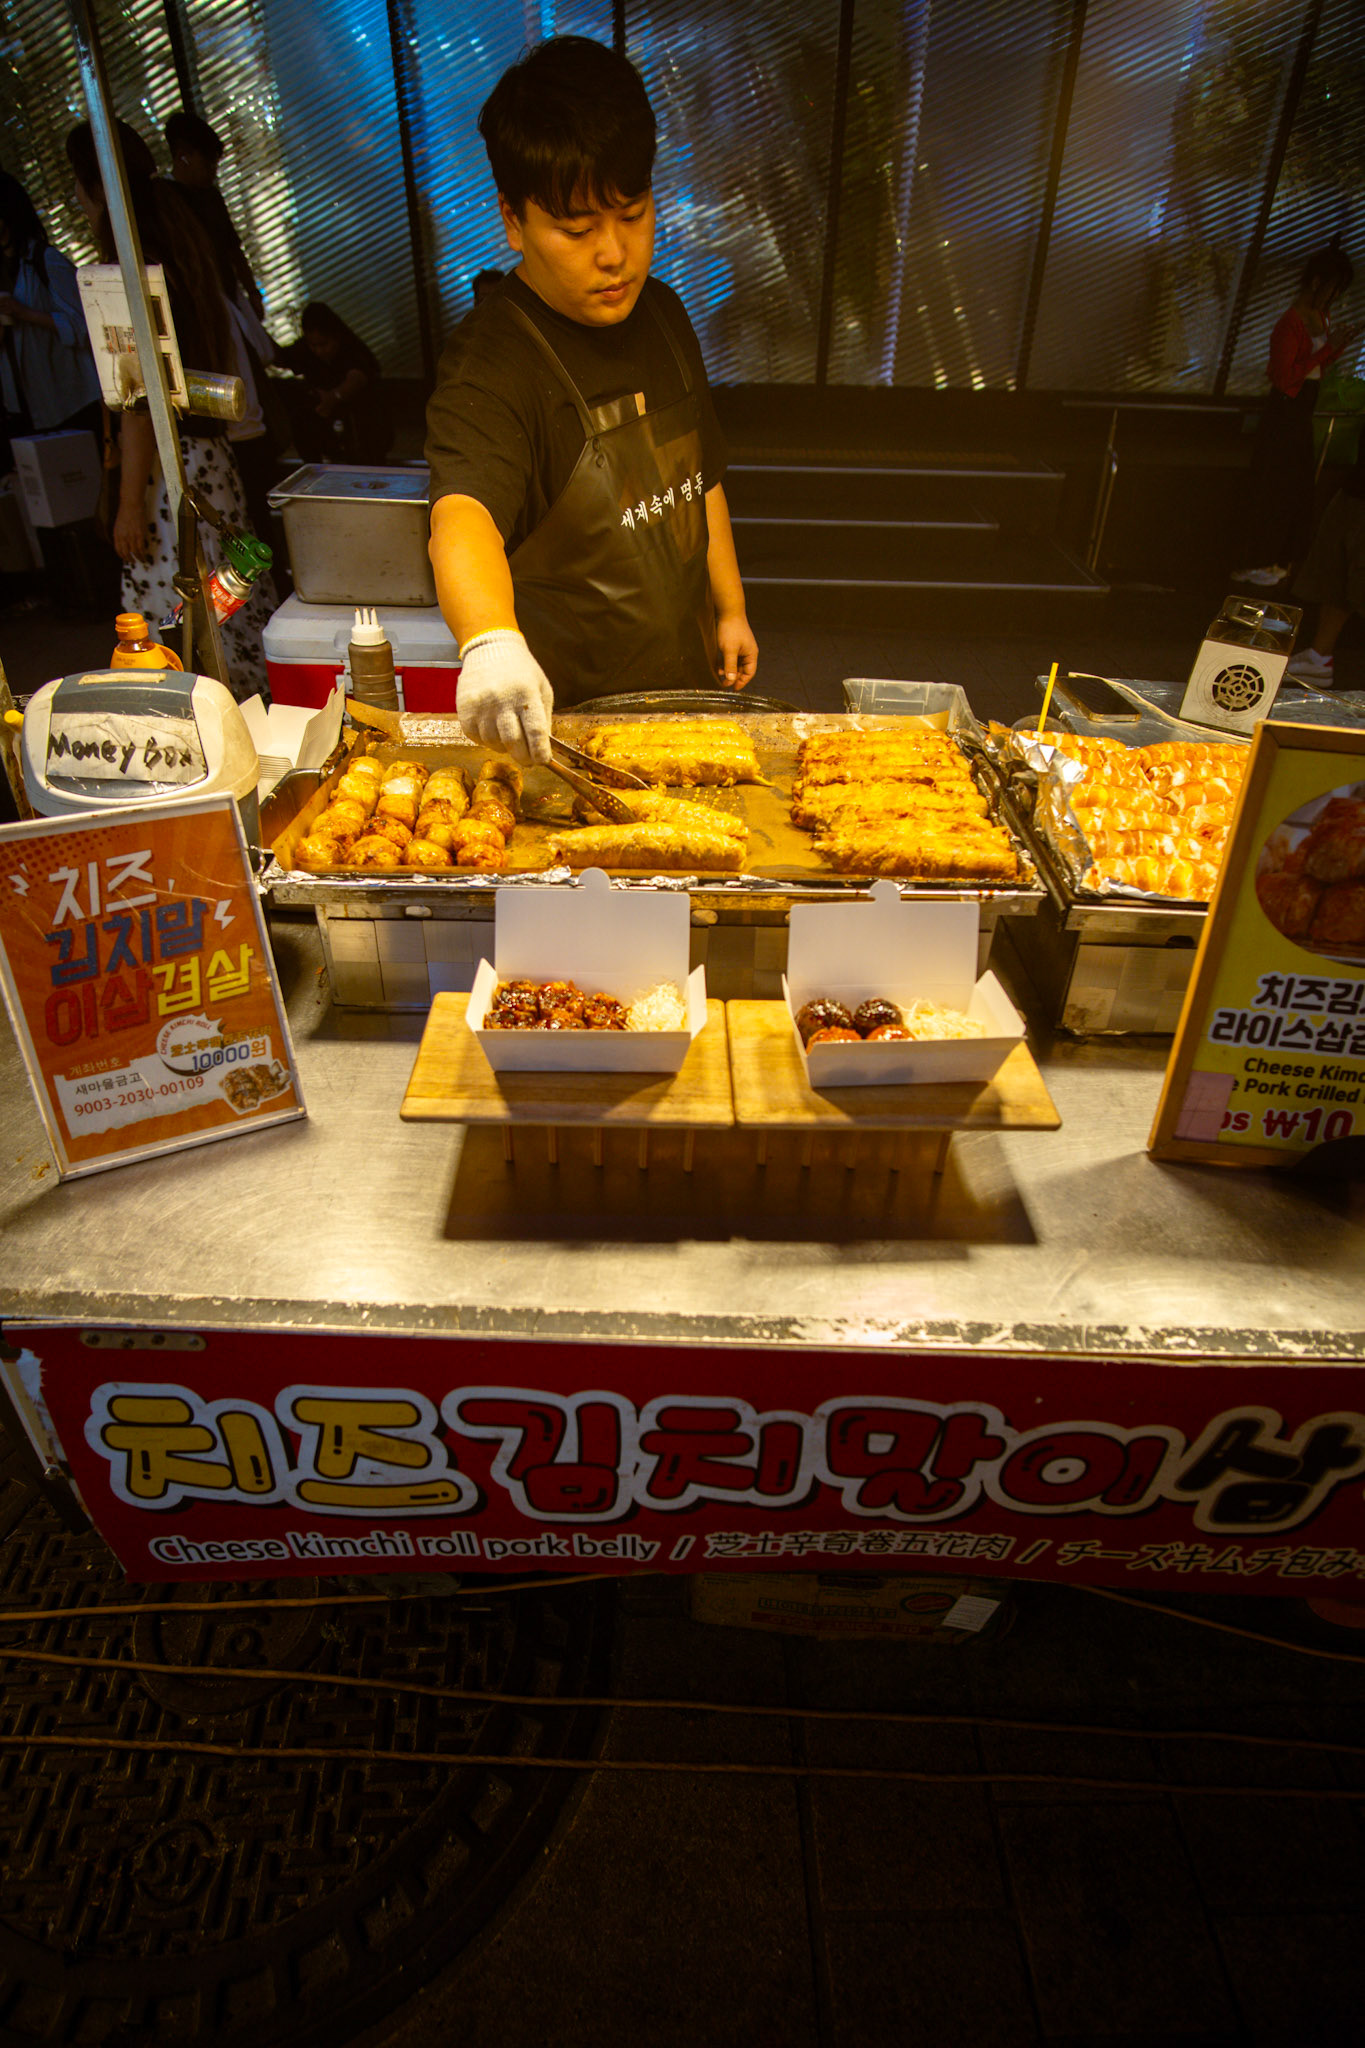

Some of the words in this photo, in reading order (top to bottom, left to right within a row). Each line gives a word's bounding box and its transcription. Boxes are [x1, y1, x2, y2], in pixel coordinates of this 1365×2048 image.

[621, 487, 675, 531] 세계속에
[680, 471, 703, 502] 명동
[48, 732, 136, 775] Money
[143, 737, 193, 770] Box
[48, 849, 157, 926] 치즈
[44, 898, 208, 986] 김치말
[44, 943, 254, 1047] 이삼겹살
[1255, 975, 1365, 1016] 치즈김
[75, 1072, 143, 1096] 새마을금고
[1244, 1057, 1315, 1079] Cheese
[74, 1076, 205, 1117] 9003-2030-00109
[1244, 1079, 1291, 1097] Pork
[1296, 1083, 1361, 1104] Grilled
[154, 1537, 286, 1563] Cheese
[298, 1532, 411, 1557] kimchi
[420, 1532, 476, 1556] roll
[489, 1534, 566, 1558] pork
[577, 1535, 657, 1560] belly
